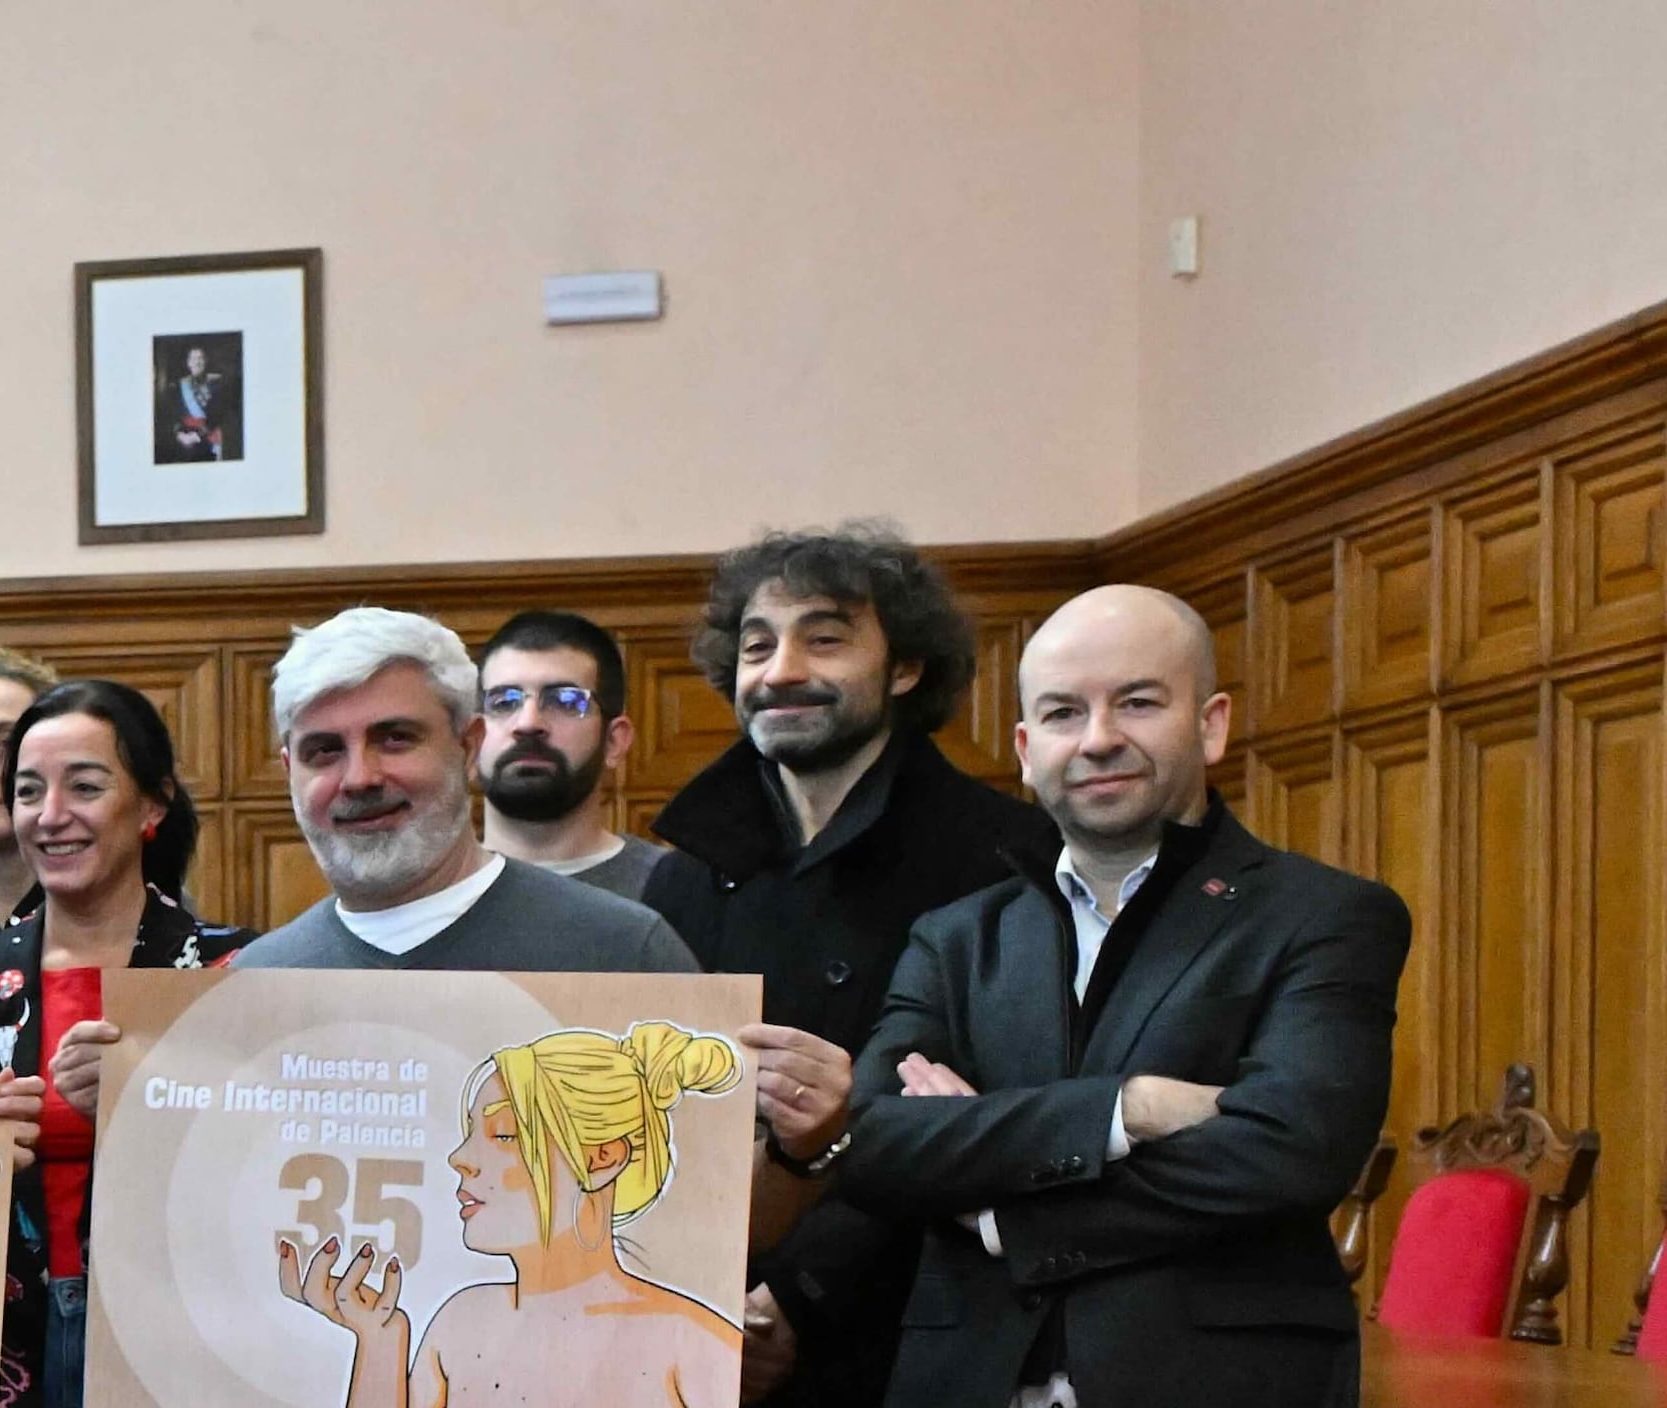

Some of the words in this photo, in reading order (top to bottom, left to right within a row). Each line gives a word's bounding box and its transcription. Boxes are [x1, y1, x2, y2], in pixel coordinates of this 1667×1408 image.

[282, 1053, 390, 1081] Muestra
[400, 1059, 428, 1082] de
[145, 1077, 211, 1110] Cine
[224, 1080, 426, 1117] Internacional
[282, 1120, 310, 1143] de
[320, 1120, 425, 1147] Palencia
[274, 1153, 424, 1275] 35
